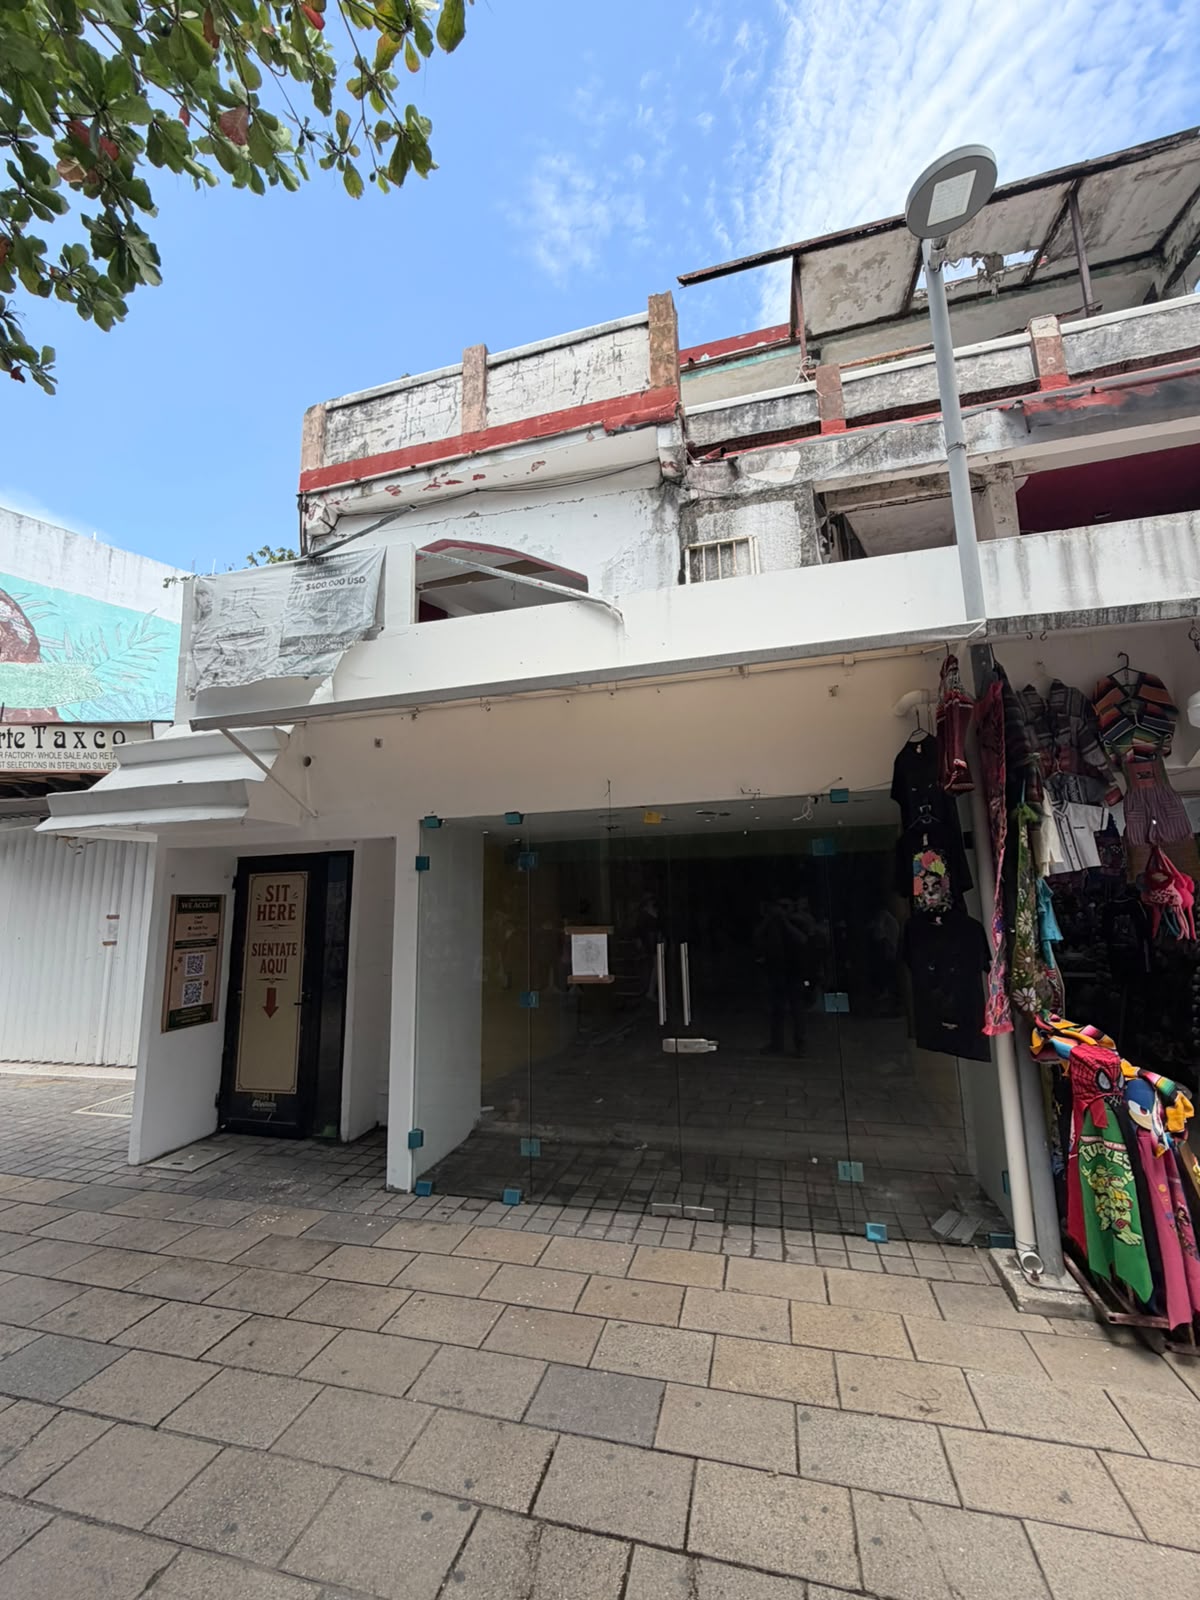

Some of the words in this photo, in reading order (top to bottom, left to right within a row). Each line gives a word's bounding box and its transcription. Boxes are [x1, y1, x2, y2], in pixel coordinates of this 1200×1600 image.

[347, 575, 367, 585] USD
[31, 725, 126, 749] Taxco
[38, 751, 61, 760] WHOLE
[63, 752, 81, 760] SALE
[82, 752, 98, 760] AND
[7, 761, 48, 769] SELECTIONS
[49, 761, 56, 769] IN
[57, 761, 91, 770] STERLING
[92, 761, 118, 770] SILVER
[265, 884, 291, 903] SIT
[256, 903, 297, 921] HERE
[251, 939, 298, 957] SIÉNTATE
